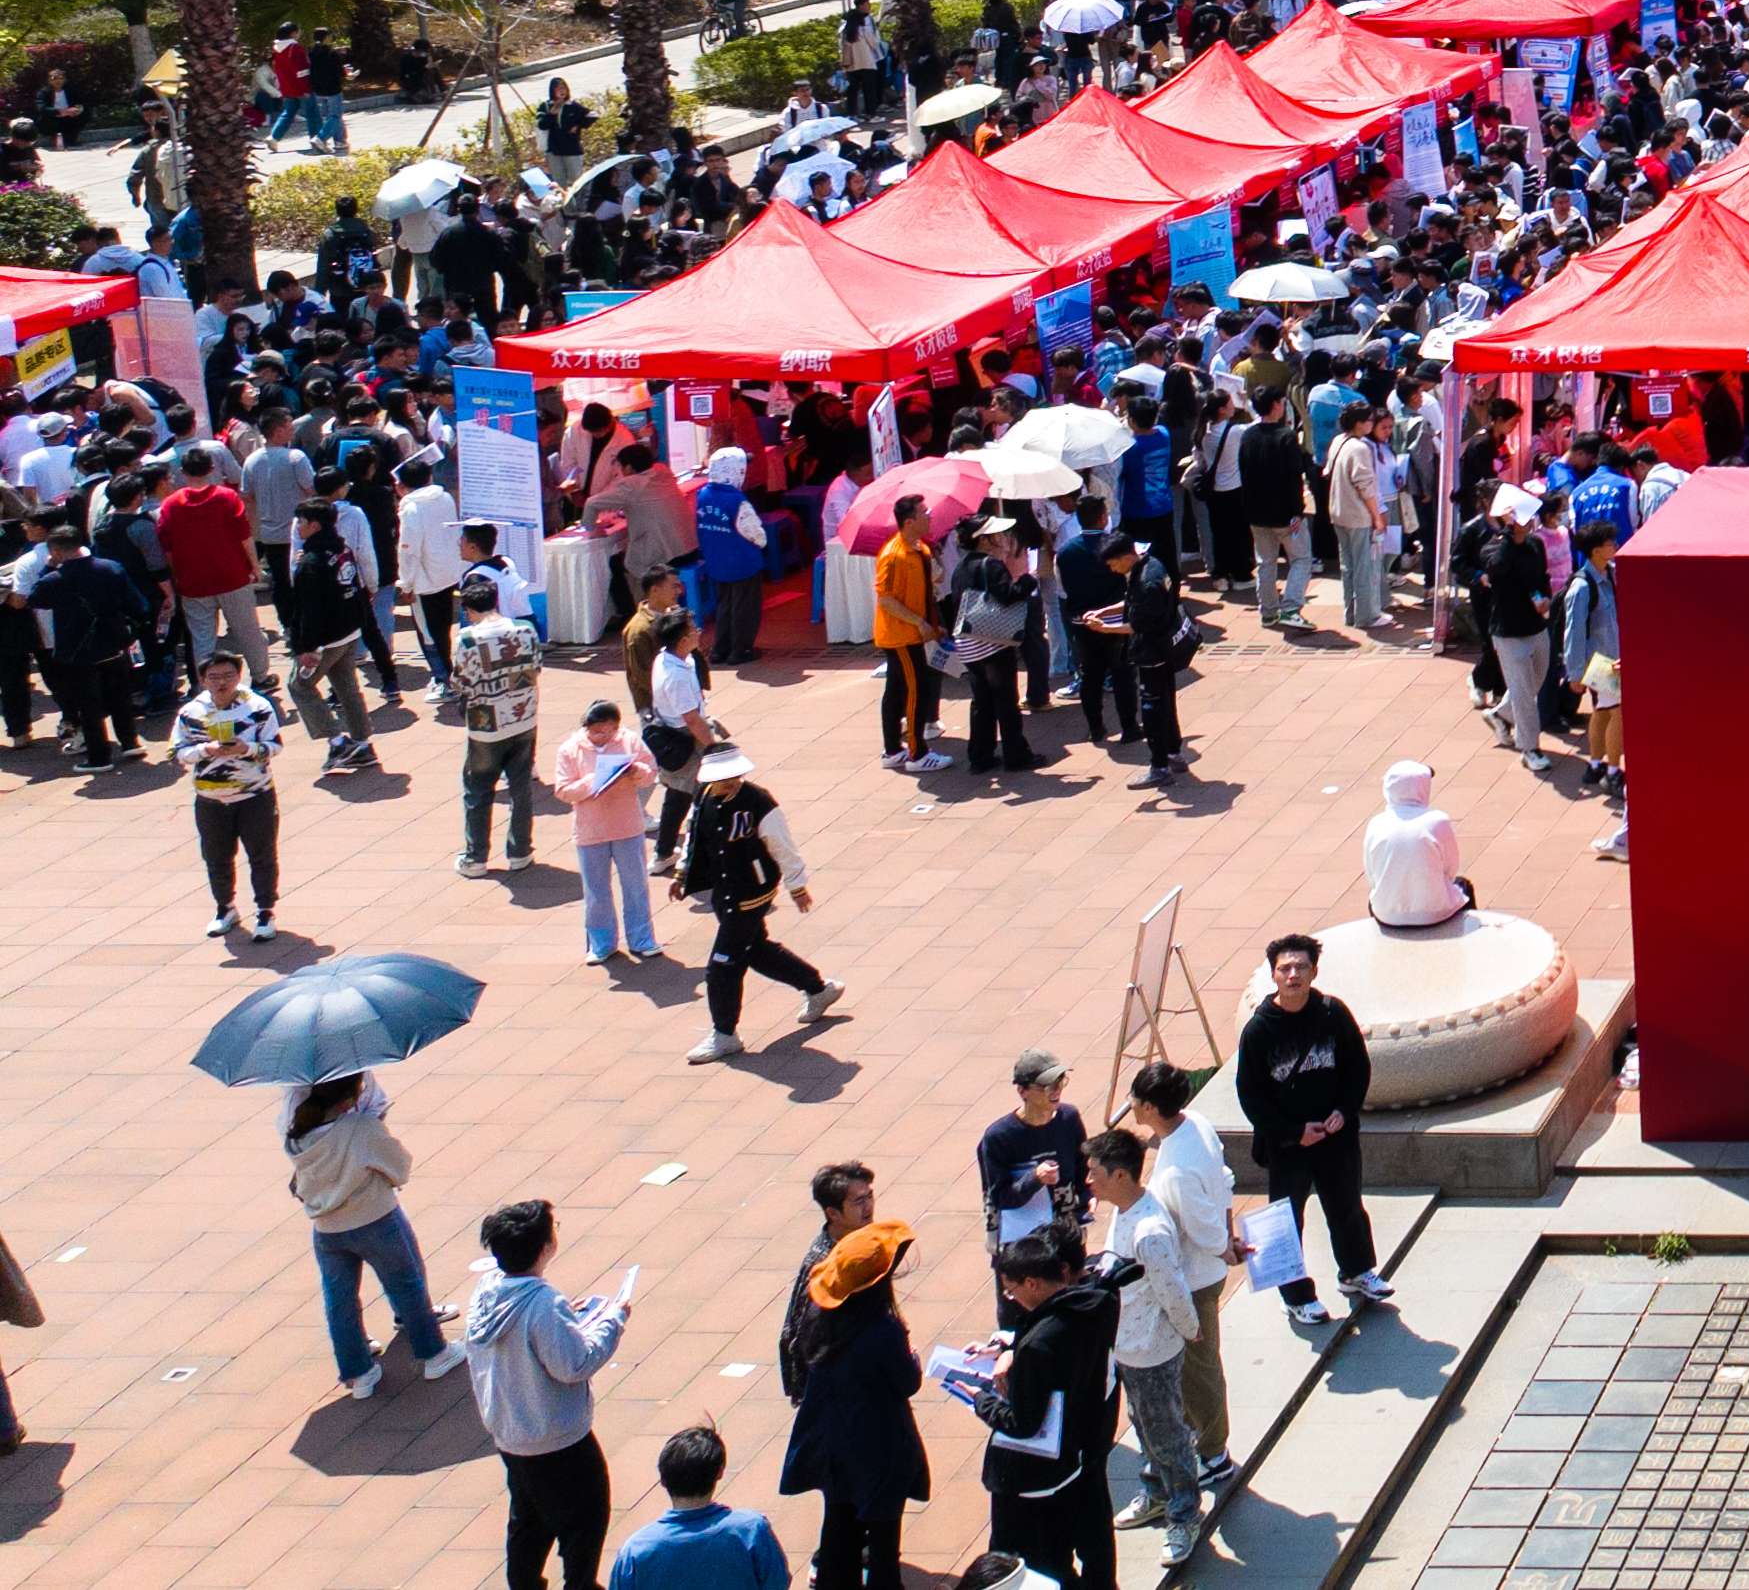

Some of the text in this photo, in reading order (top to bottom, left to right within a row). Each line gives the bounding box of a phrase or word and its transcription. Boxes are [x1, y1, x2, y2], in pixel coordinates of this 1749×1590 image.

[551, 348, 641, 370] 众才校招
[779, 349, 833, 372] 纳职
[1510, 345, 1604, 366] 众才校招
